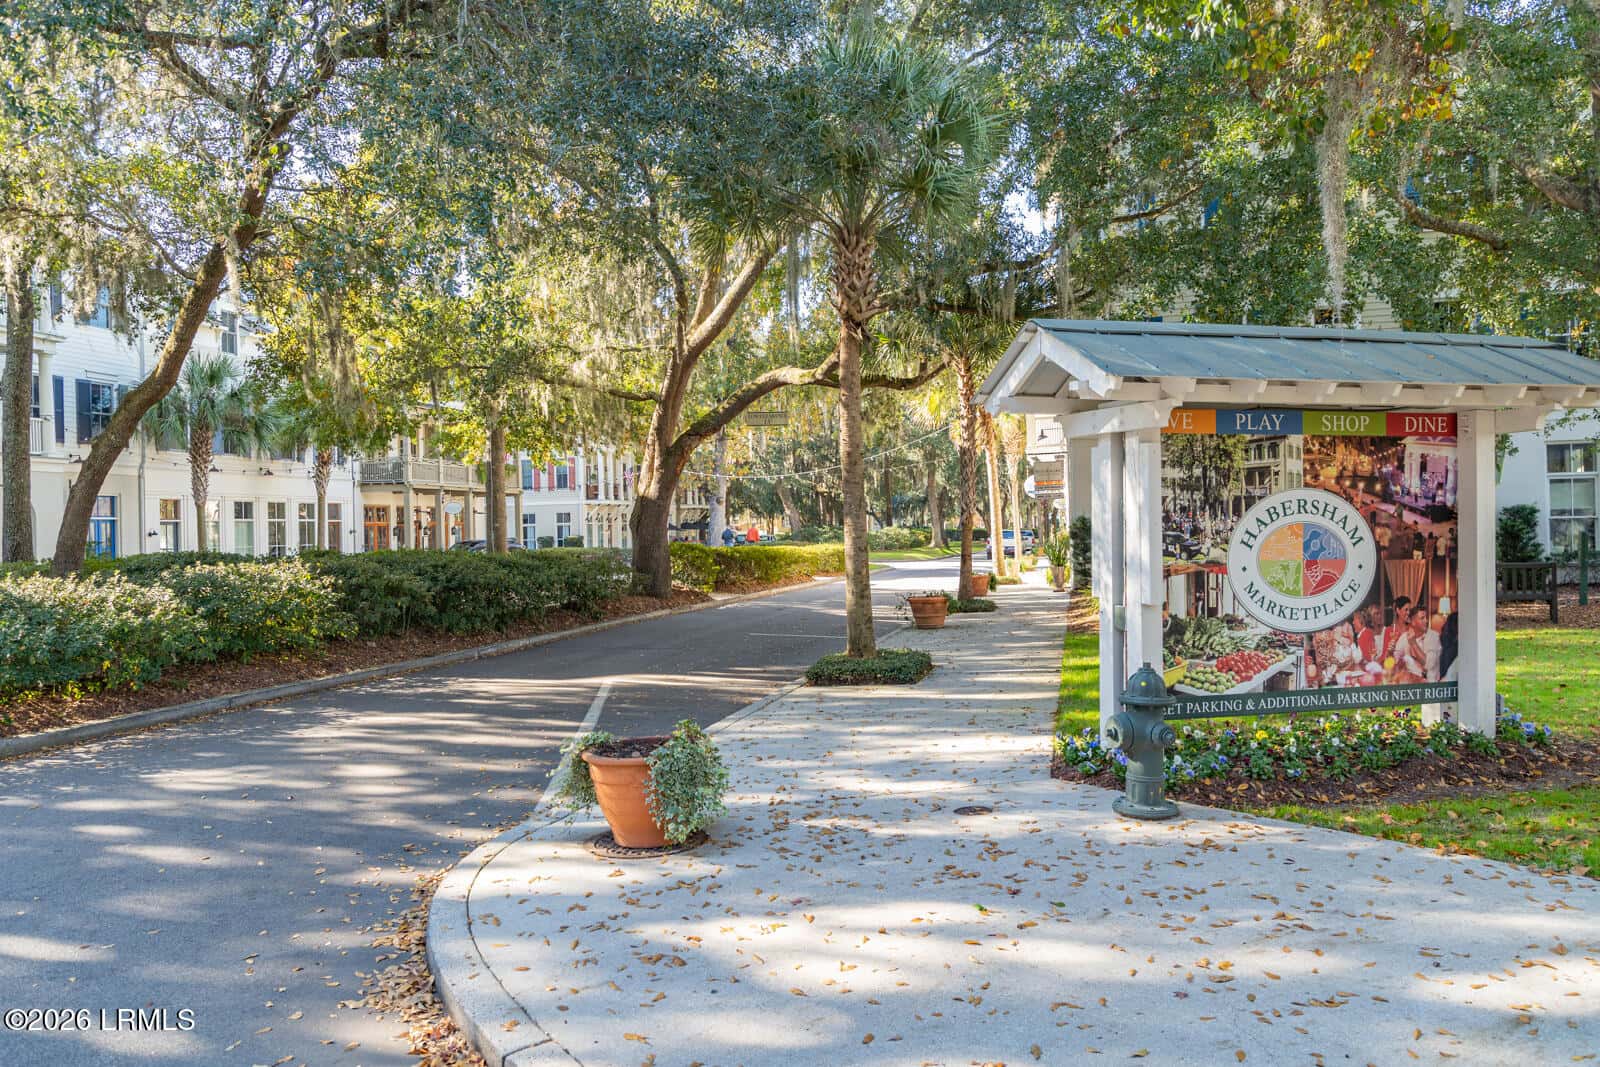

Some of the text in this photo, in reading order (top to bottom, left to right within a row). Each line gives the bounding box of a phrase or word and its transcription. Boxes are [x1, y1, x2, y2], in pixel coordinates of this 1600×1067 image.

[1169, 412, 1448, 433] VE PLAY SHOP DINE
[1240, 498, 1364, 550] HABERSHAM
[1243, 578, 1361, 621] MARKETPLACE
[1186, 700, 1242, 714] PARKING
[1245, 698, 1255, 710] &
[1257, 693, 1334, 709] ADDITIONAL
[1337, 690, 1389, 704] PARKING
[1391, 688, 1422, 701] NEXT
[1424, 686, 1458, 699] RIGHT
